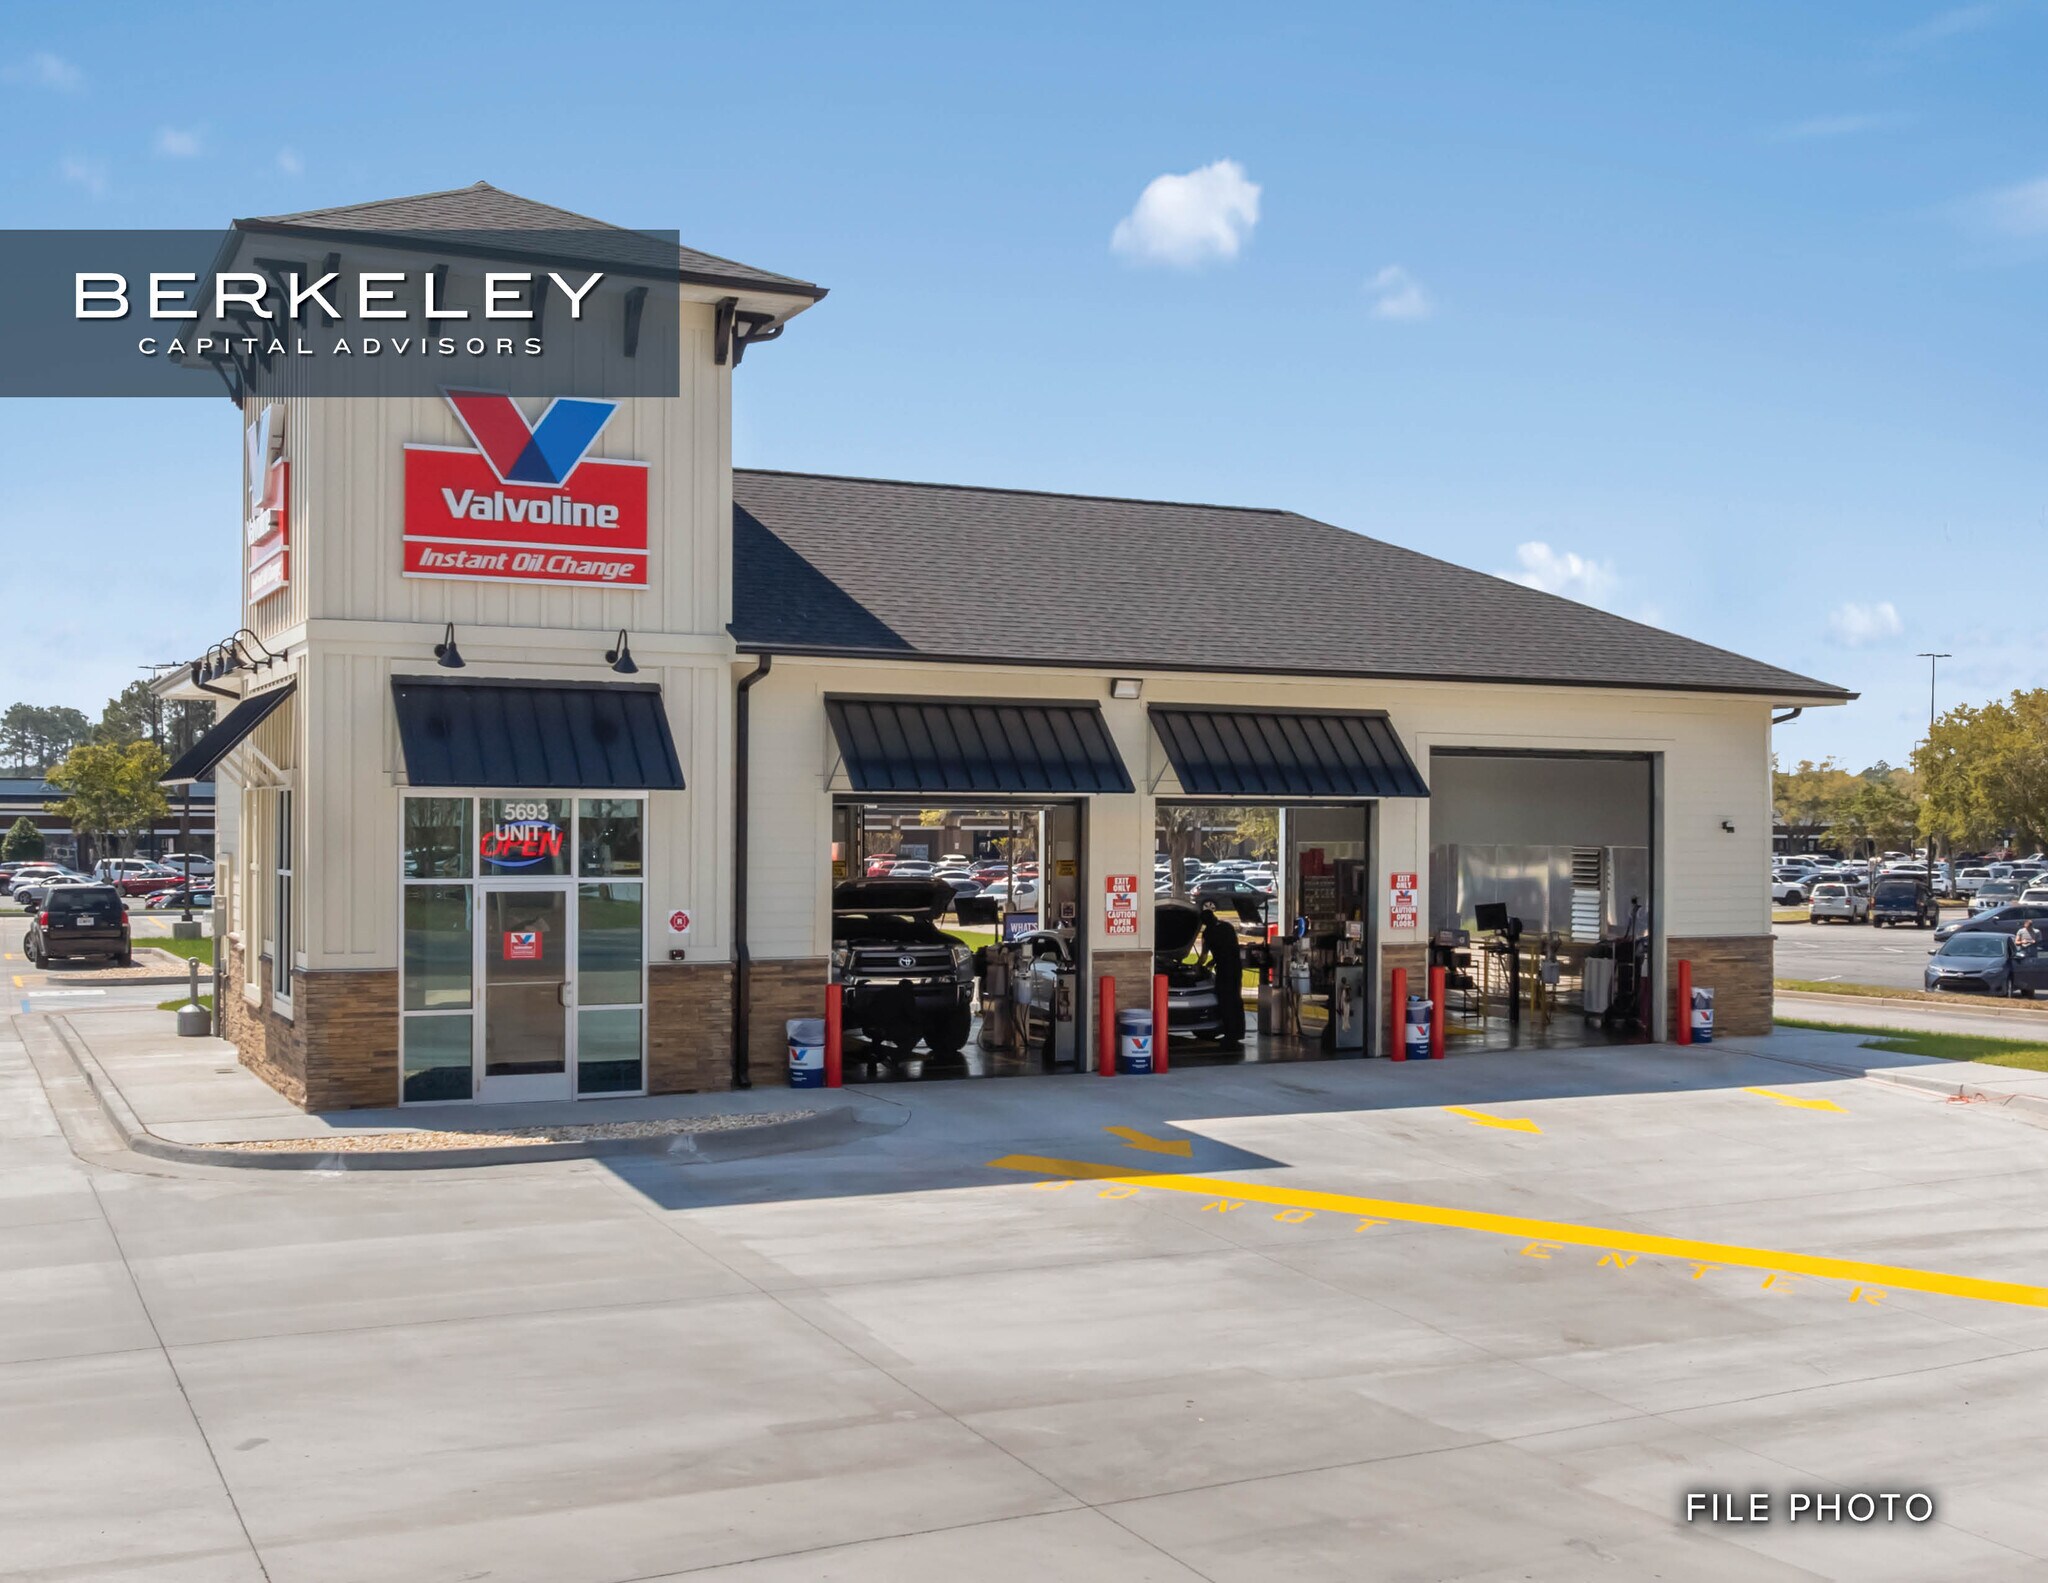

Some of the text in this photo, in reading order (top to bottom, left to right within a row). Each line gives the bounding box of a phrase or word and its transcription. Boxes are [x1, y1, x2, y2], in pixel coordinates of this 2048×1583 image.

[441, 487, 620, 529] Valvoline
[419, 548, 636, 580] Instant Oil Change
[504, 803, 549, 821] 5693
[495, 824, 556, 841] UNIT 1
[480, 831, 564, 857] OPEN
[1114, 877, 1129, 885] EXIT
[1396, 881, 1412, 889] ONLY
[1112, 884, 1131, 892] ONLY
[1391, 905, 1416, 914] CAUTION
[1107, 910, 1136, 919] CAUTION
[1396, 913, 1412, 921] OPEN
[1113, 918, 1131, 926] OPEN
[1110, 925, 1135, 933] FLOORS
[1201, 1199, 1390, 1233] NOT
[1519, 1242, 1889, 1306] ENTER
